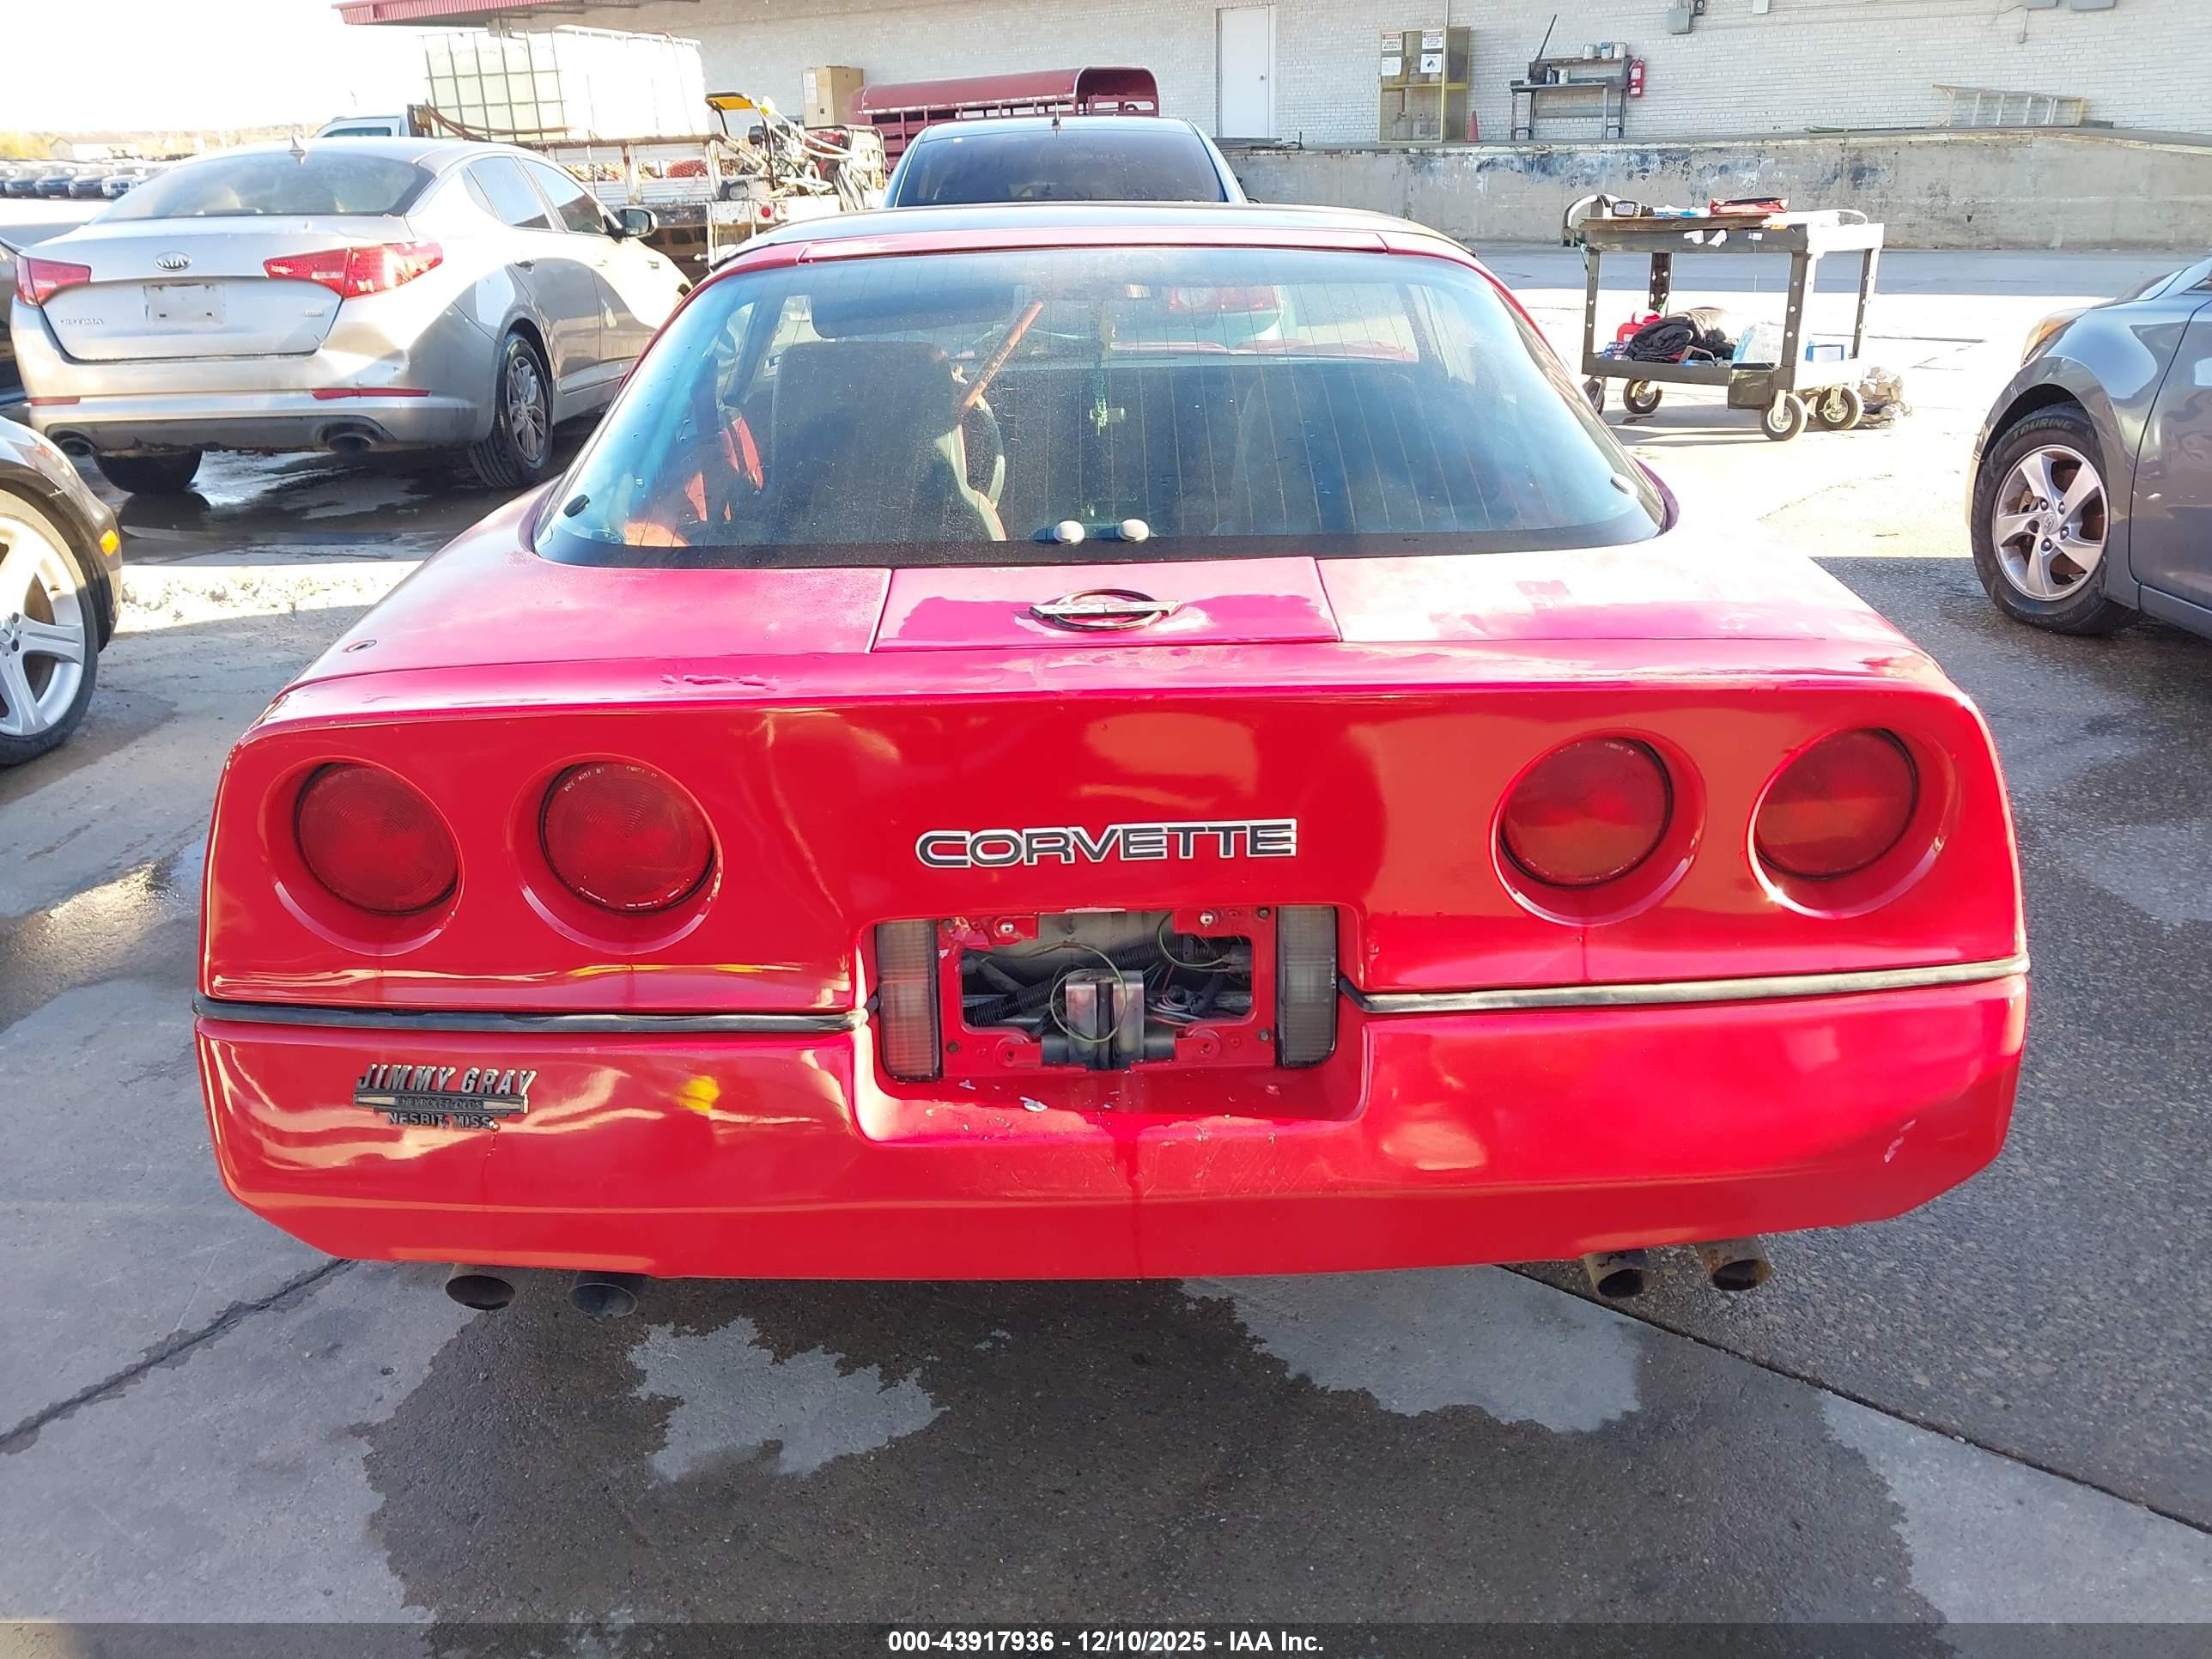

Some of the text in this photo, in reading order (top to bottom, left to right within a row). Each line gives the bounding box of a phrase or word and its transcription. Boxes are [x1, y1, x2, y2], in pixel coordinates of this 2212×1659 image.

[2012, 417, 2075, 440] TOURING
[915, 818, 1297, 868] CORVETTE
[357, 1063, 538, 1096] JIMMY GRAY
